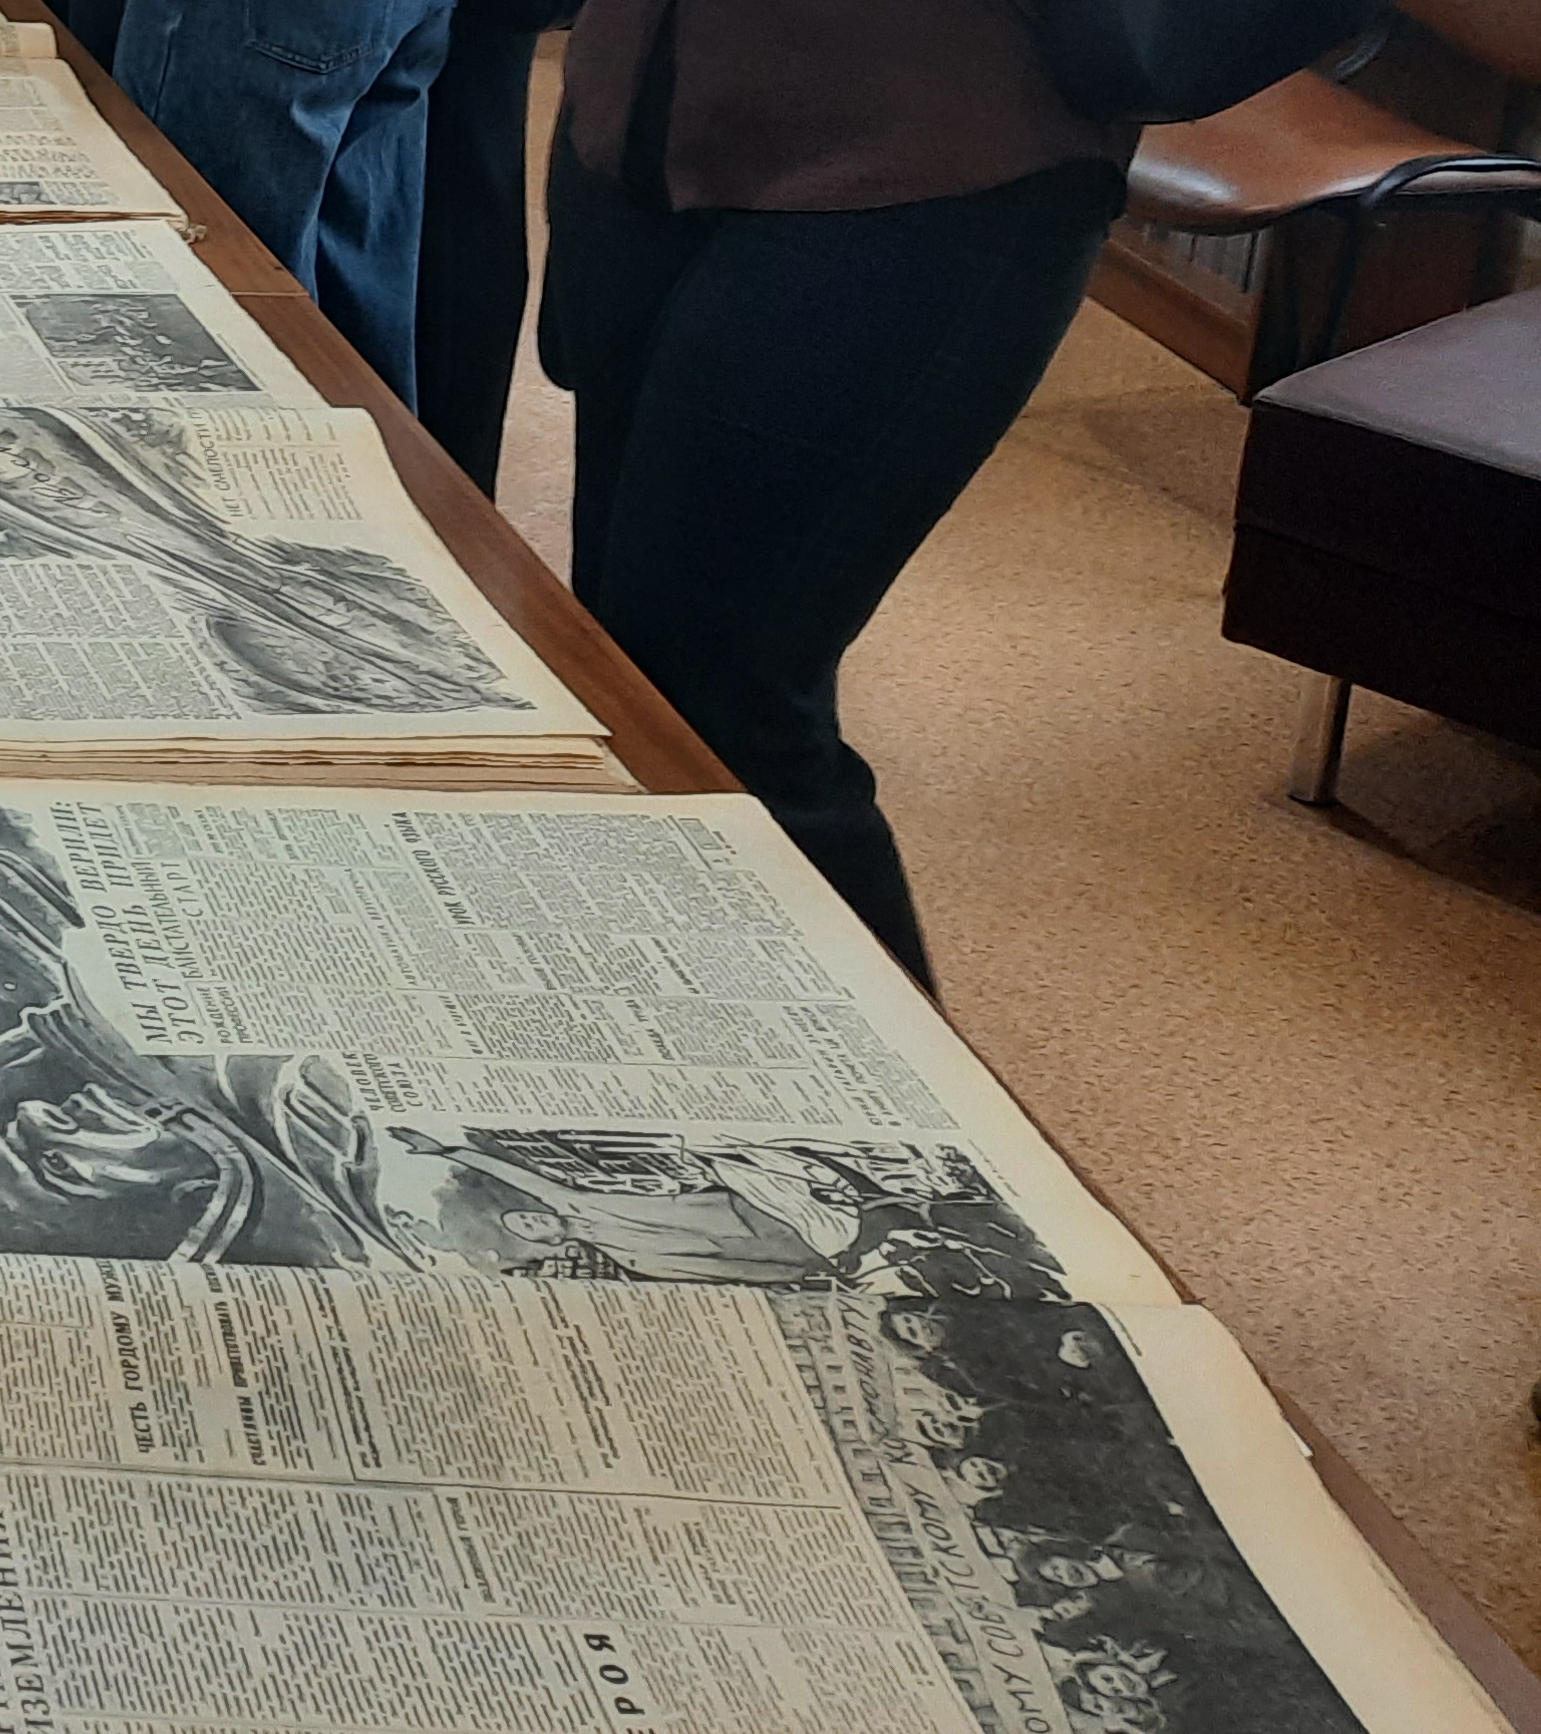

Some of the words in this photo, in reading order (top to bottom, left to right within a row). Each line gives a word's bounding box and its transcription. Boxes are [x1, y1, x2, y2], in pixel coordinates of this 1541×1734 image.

[50, 801, 107, 892] ВЕРИЛИ:
[77, 801, 134, 887] ПРИДЕТ
[412, 849, 455, 897] РУССКОГО
[161, 861, 204, 919] СТАРТ
[91, 905, 148, 990] ТВЕРДО
[122, 905, 175, 969] ДЕНЬ
[131, 1002, 173, 1044] МЫ
[155, 978, 204, 1045] ЭТОТ
[342, 1051, 384, 1112] ЧЕЛОВЕК
[110, 1310, 144, 1392] ГОРДОМУ
[128, 1401, 156, 1454] ЧЕСТЬ
[903, 1481, 1025, 1658] СОВЕТСКОМУ
[583, 1633, 655, 1734] РОЯ
[993, 1662, 1048, 1734] ОМУ
